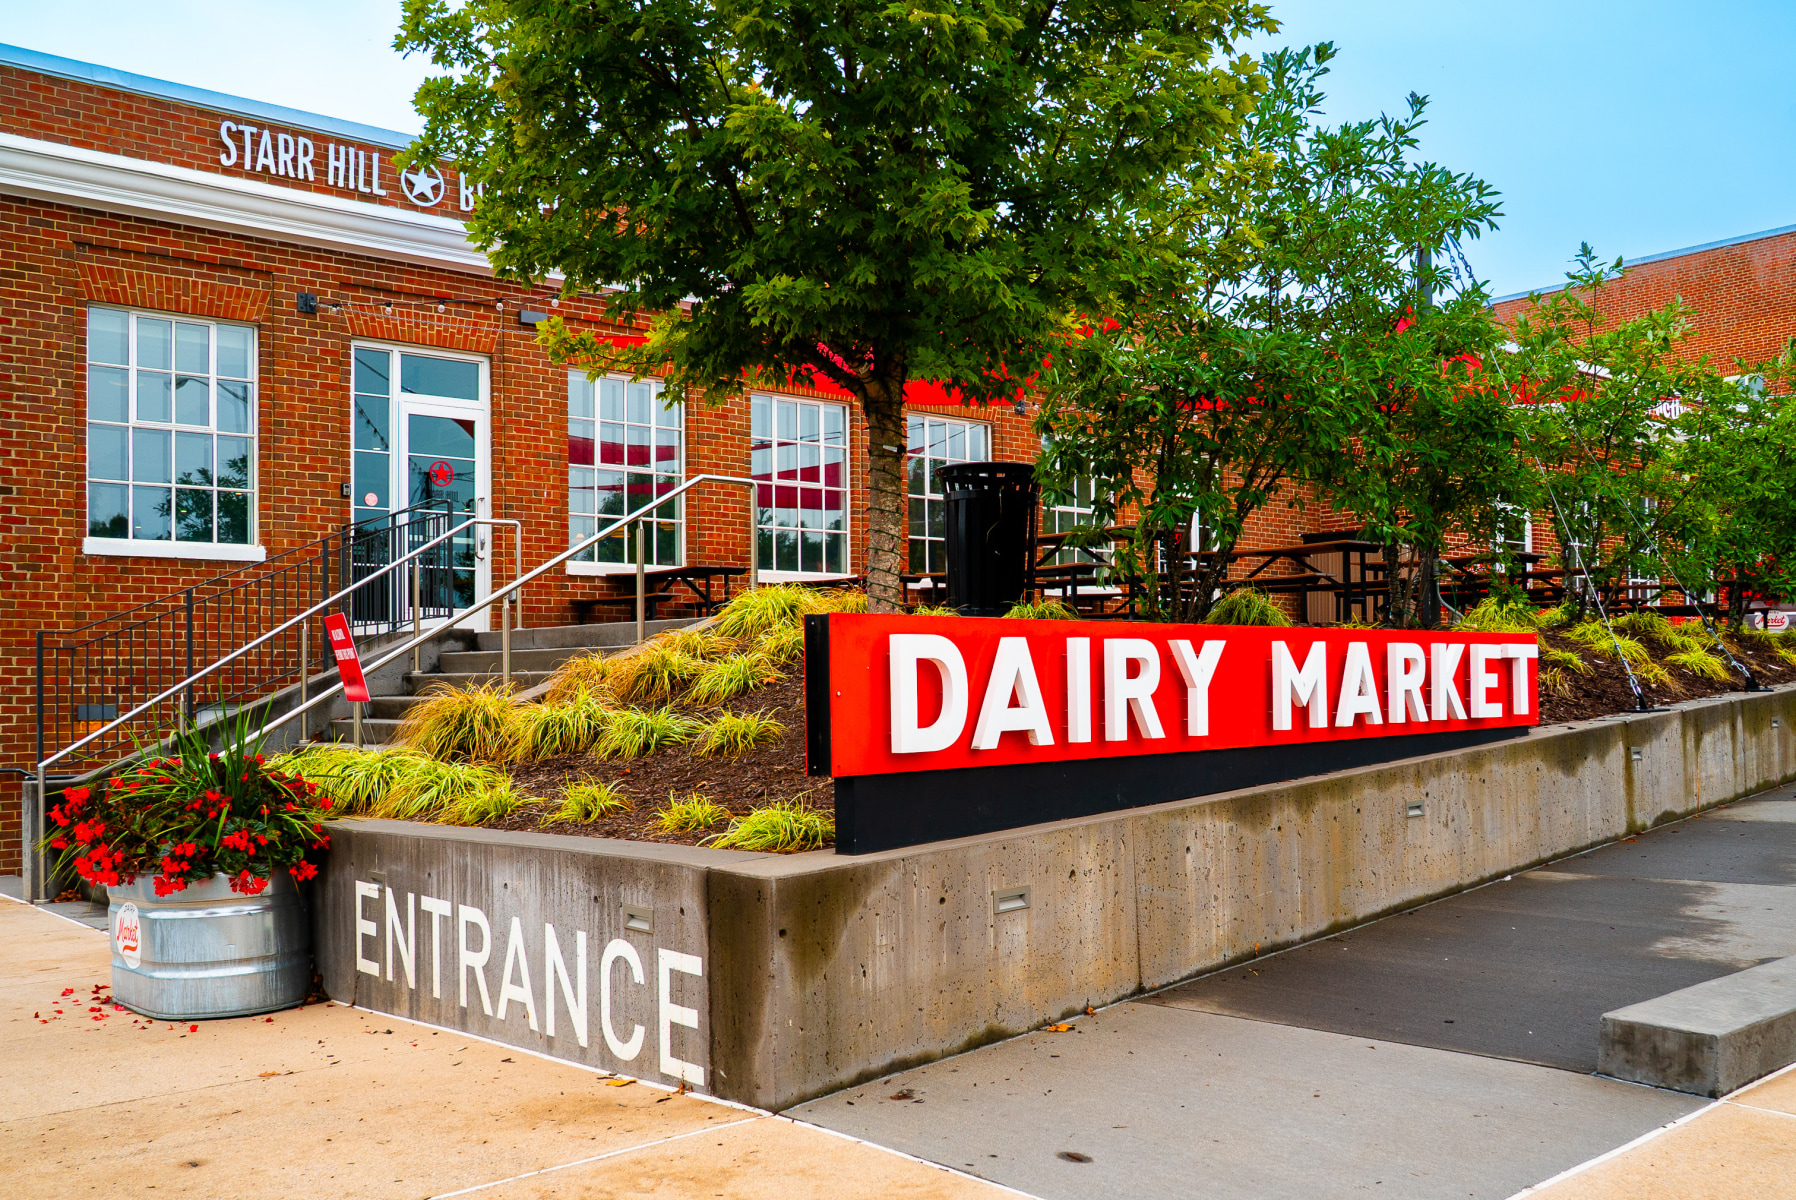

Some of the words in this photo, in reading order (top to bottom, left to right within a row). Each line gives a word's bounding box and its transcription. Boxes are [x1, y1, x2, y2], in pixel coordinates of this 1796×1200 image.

[219, 120, 315, 182] STARR
[328, 143, 387, 196] HILL
[889, 633, 1226, 754] DAIRY
[1272, 640, 1539, 732] MARKET
[116, 916, 138, 945] Market
[355, 880, 704, 1086] ENTRANCE
